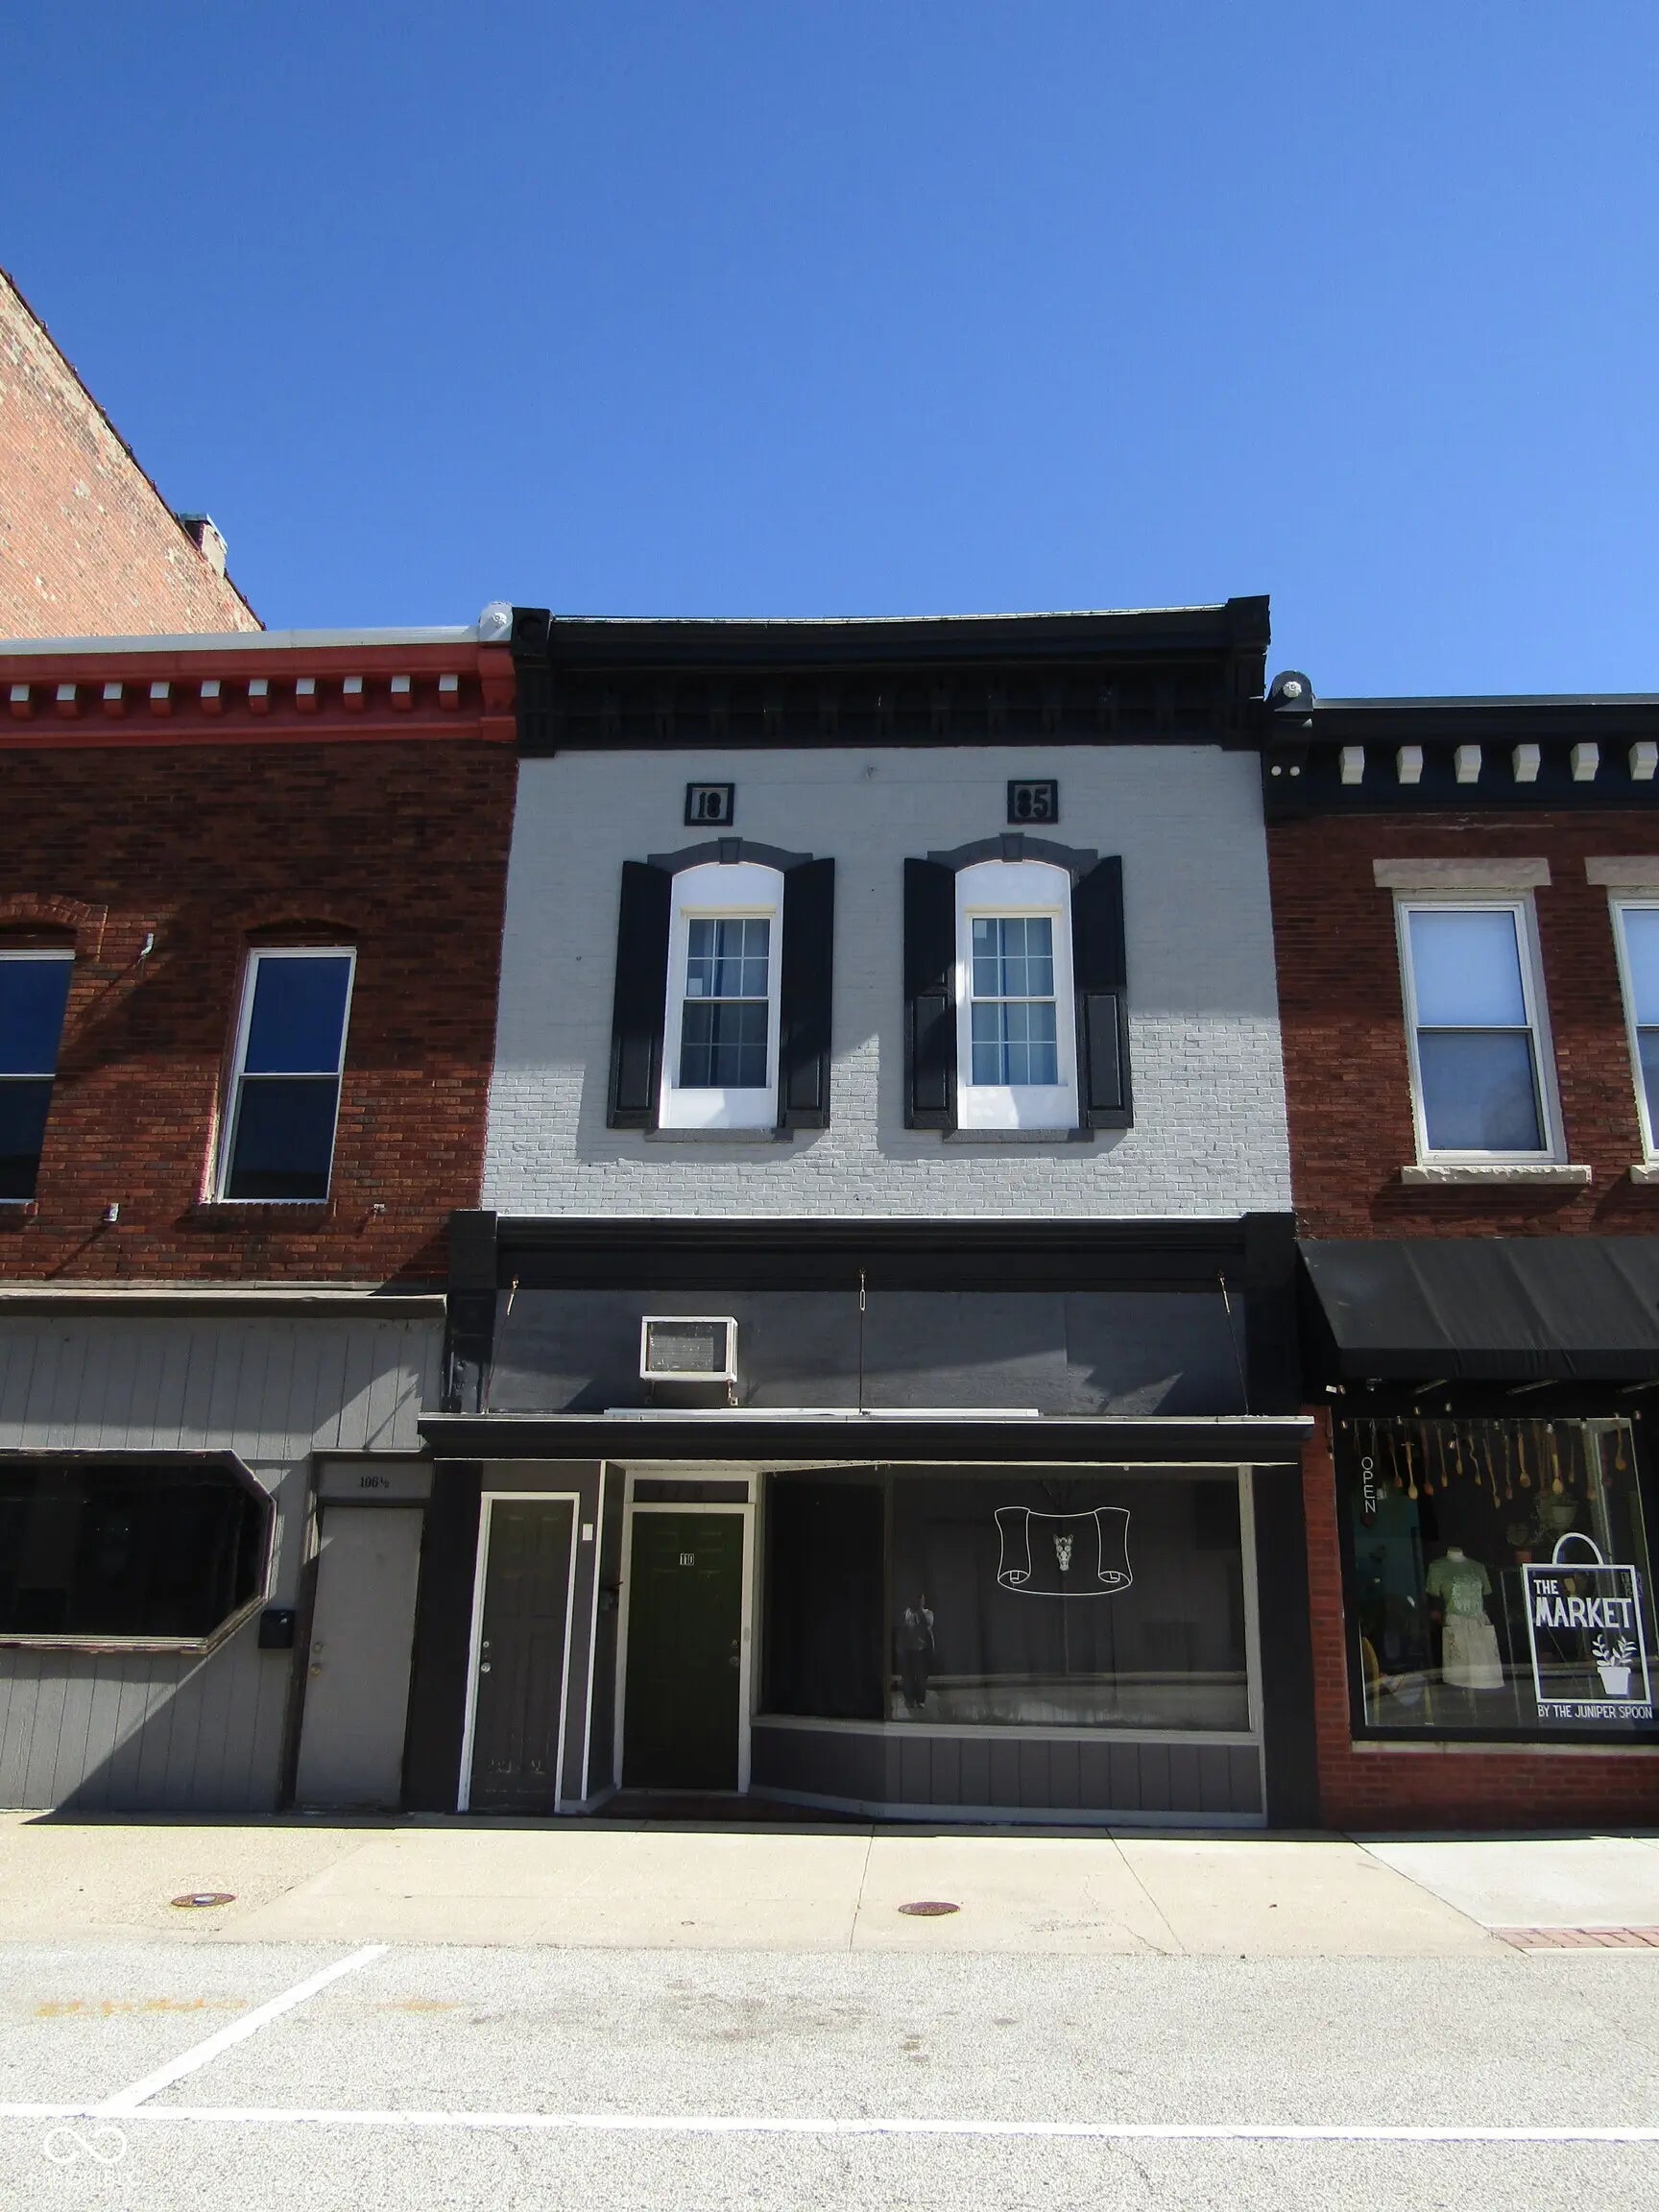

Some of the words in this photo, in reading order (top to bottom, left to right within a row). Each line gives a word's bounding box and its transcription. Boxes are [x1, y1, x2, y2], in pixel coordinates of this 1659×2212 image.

[697, 790, 722, 819] 18
[1017, 788, 1048, 818] 85
[1361, 1456, 1376, 1513] OPEN
[1533, 1579, 1559, 1595] THE
[1535, 1597, 1632, 1628] MARKET
[1537, 1704, 1550, 1718] BY
[1552, 1705, 1573, 1718] THE
[1575, 1705, 1617, 1719] JUNIPER
[1618, 1706, 1653, 1719] SPOON
